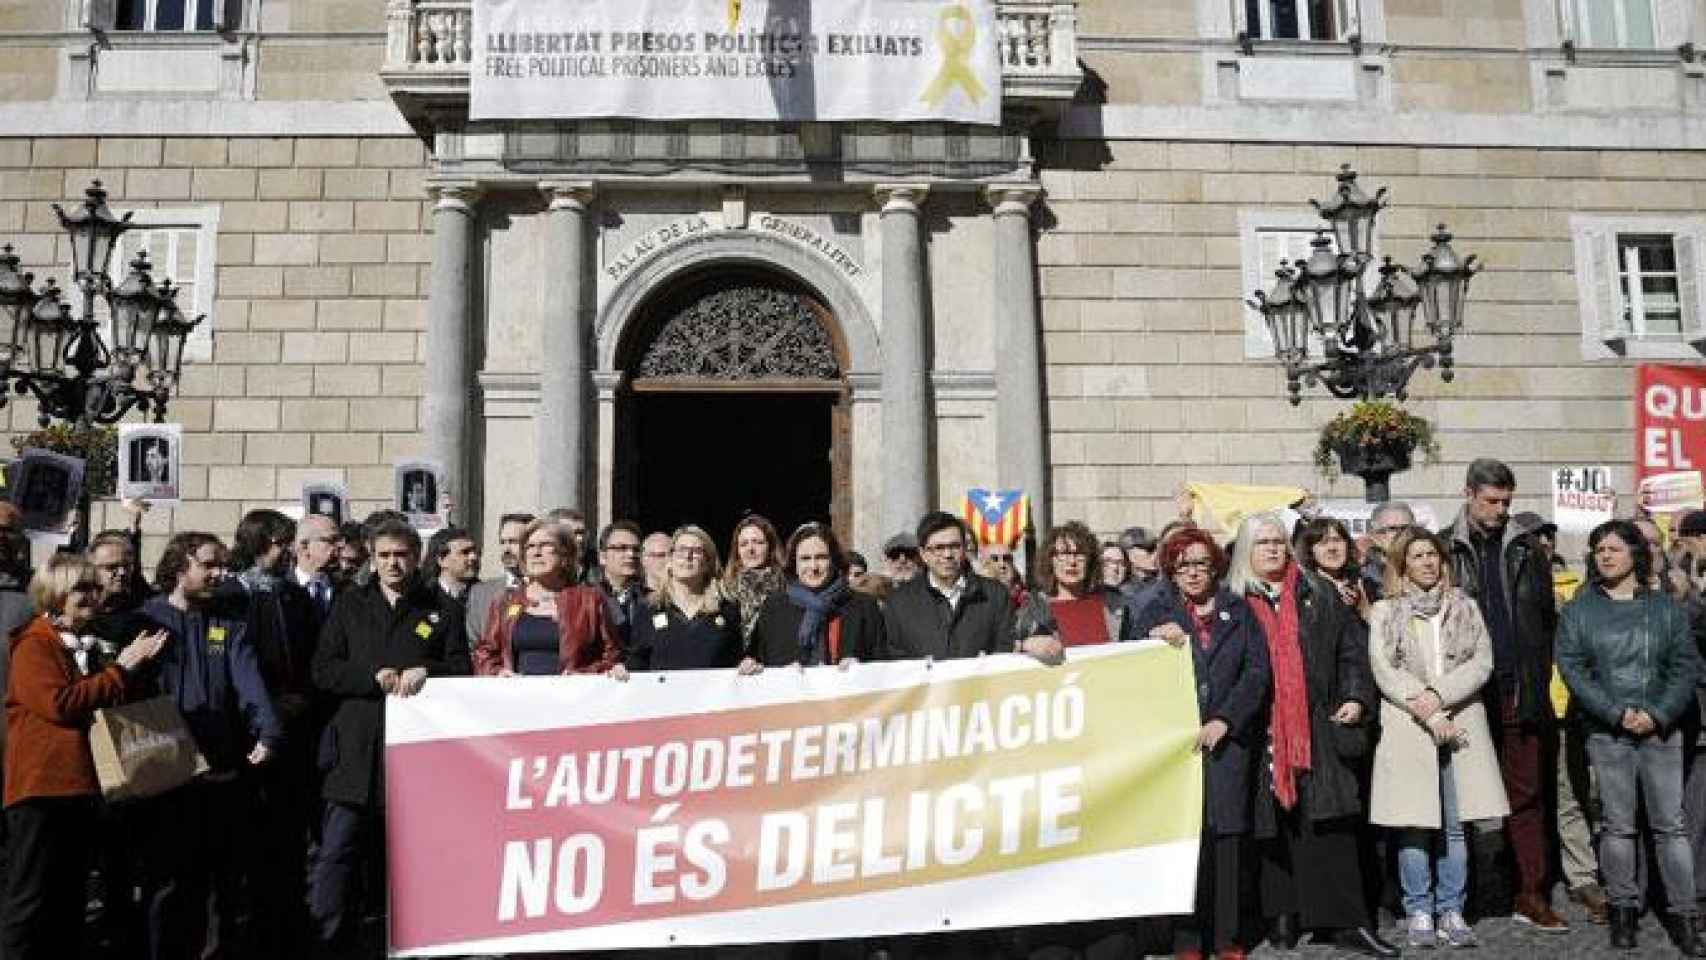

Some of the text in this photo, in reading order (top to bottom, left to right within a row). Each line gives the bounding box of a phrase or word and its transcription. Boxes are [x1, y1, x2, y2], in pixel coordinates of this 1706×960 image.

[486, 32, 602, 53] LLIBERTAT
[611, 32, 697, 53] PRESOS
[828, 34, 924, 56] EXILIATS
[485, 55, 796, 78] FREE POLITICAL PRISONERS AND EXILES
[1645, 429, 1692, 468] EL
[506, 673, 1085, 810] L'AUTODETERMINACIÓ
[498, 766, 1083, 921] NO ÉS DELICTE
